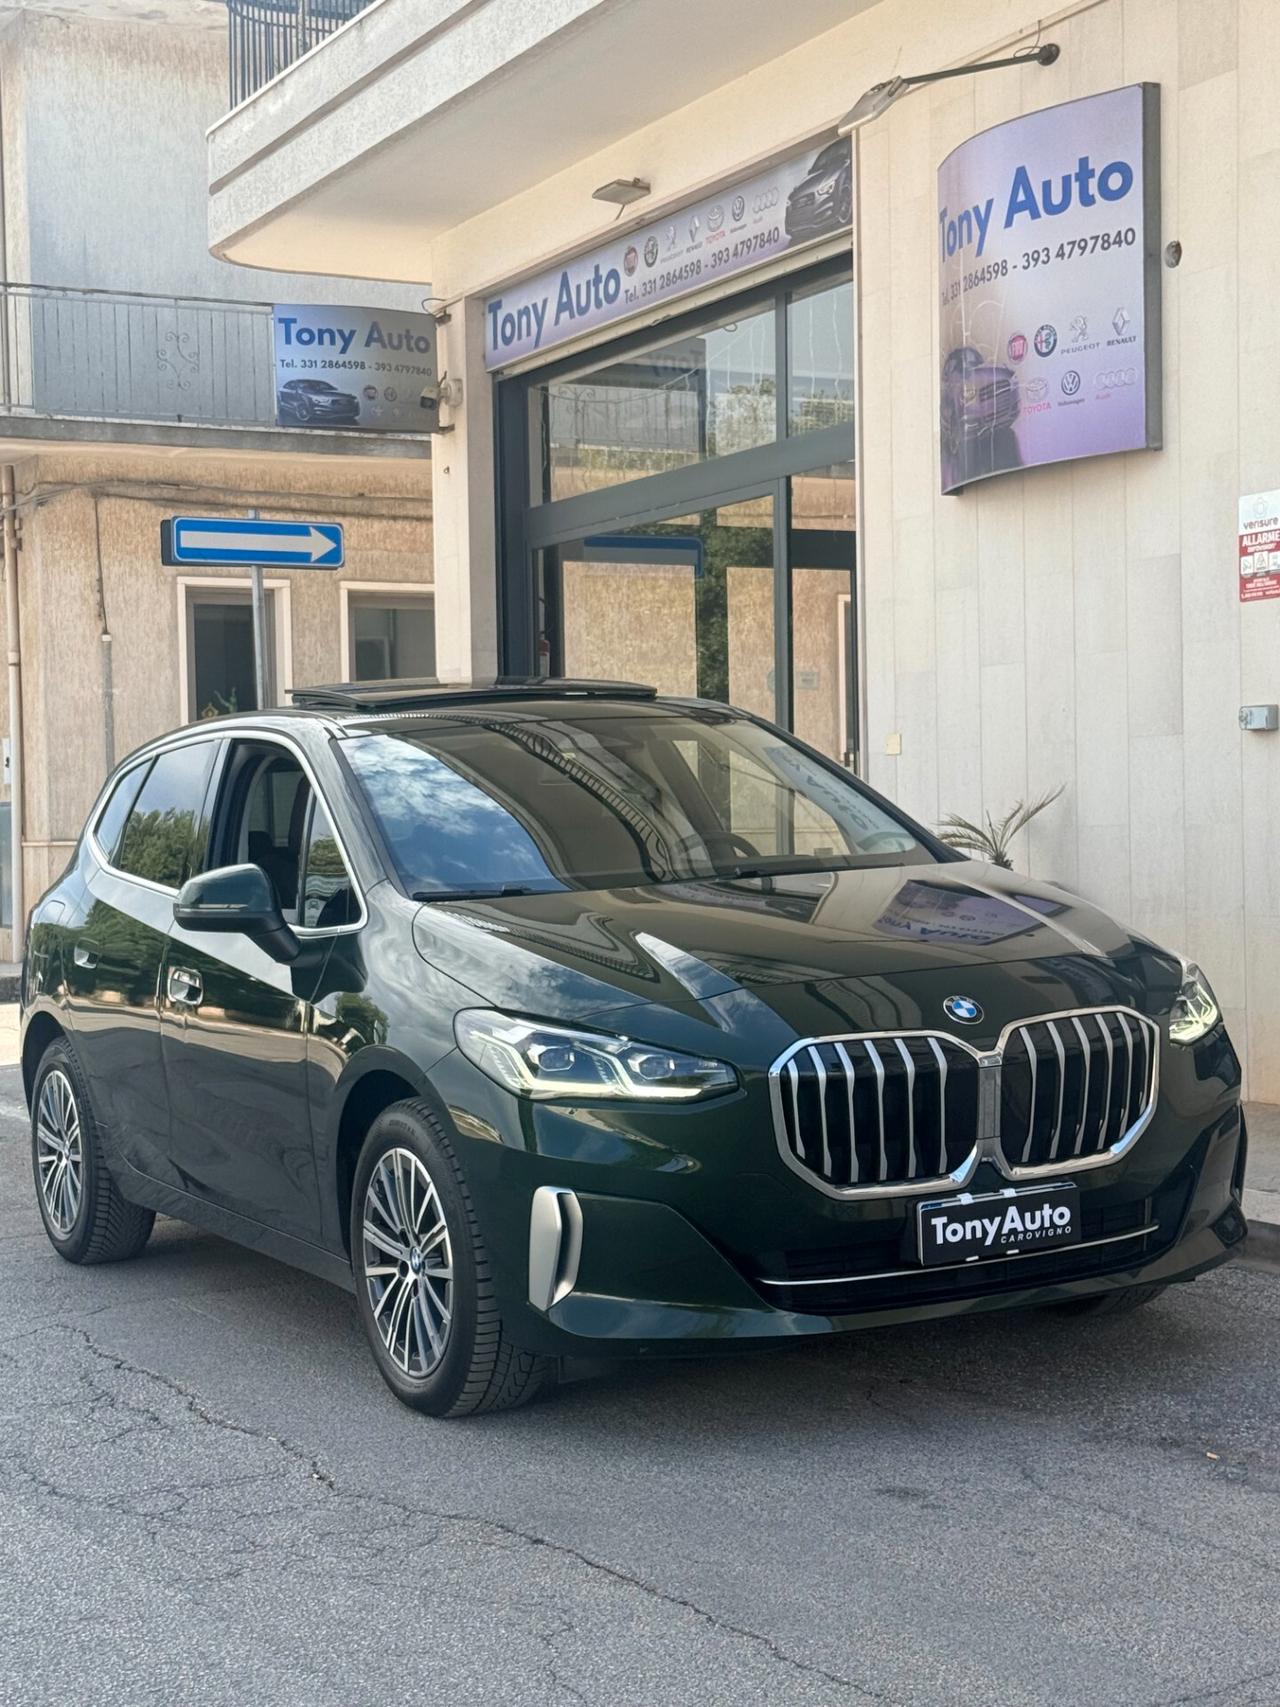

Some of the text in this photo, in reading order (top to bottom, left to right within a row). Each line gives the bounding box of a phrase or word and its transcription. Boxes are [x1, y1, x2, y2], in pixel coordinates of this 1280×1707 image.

[939, 156, 1134, 263] Tony Auto
[624, 285, 640, 305] Tel.
[641, 277, 657, 297] 331
[659, 259, 702, 290] 2864598
[710, 247, 730, 269] 393
[732, 226, 780, 259] 4797840
[962, 259, 1009, 293] 2864598
[1022, 247, 1051, 271] 393
[1055, 227, 1136, 261] 4797840
[488, 264, 621, 351] Tony Auto
[278, 317, 431, 355] Tony Auto
[1106, 335, 1137, 347] RENAULT
[1060, 342, 1101, 356] PEUGEOT
[280, 358, 298, 369] Tel.
[300, 359, 318, 369] 331
[320, 359, 366, 370] 2864598
[374, 362, 392, 373] 393
[394, 364, 433, 377] 4797840
[1243, 517, 1279, 531] verisure
[1241, 529, 1280, 547] ALLARME
[1000, 1225, 1072, 1244] CAROVIGNO
